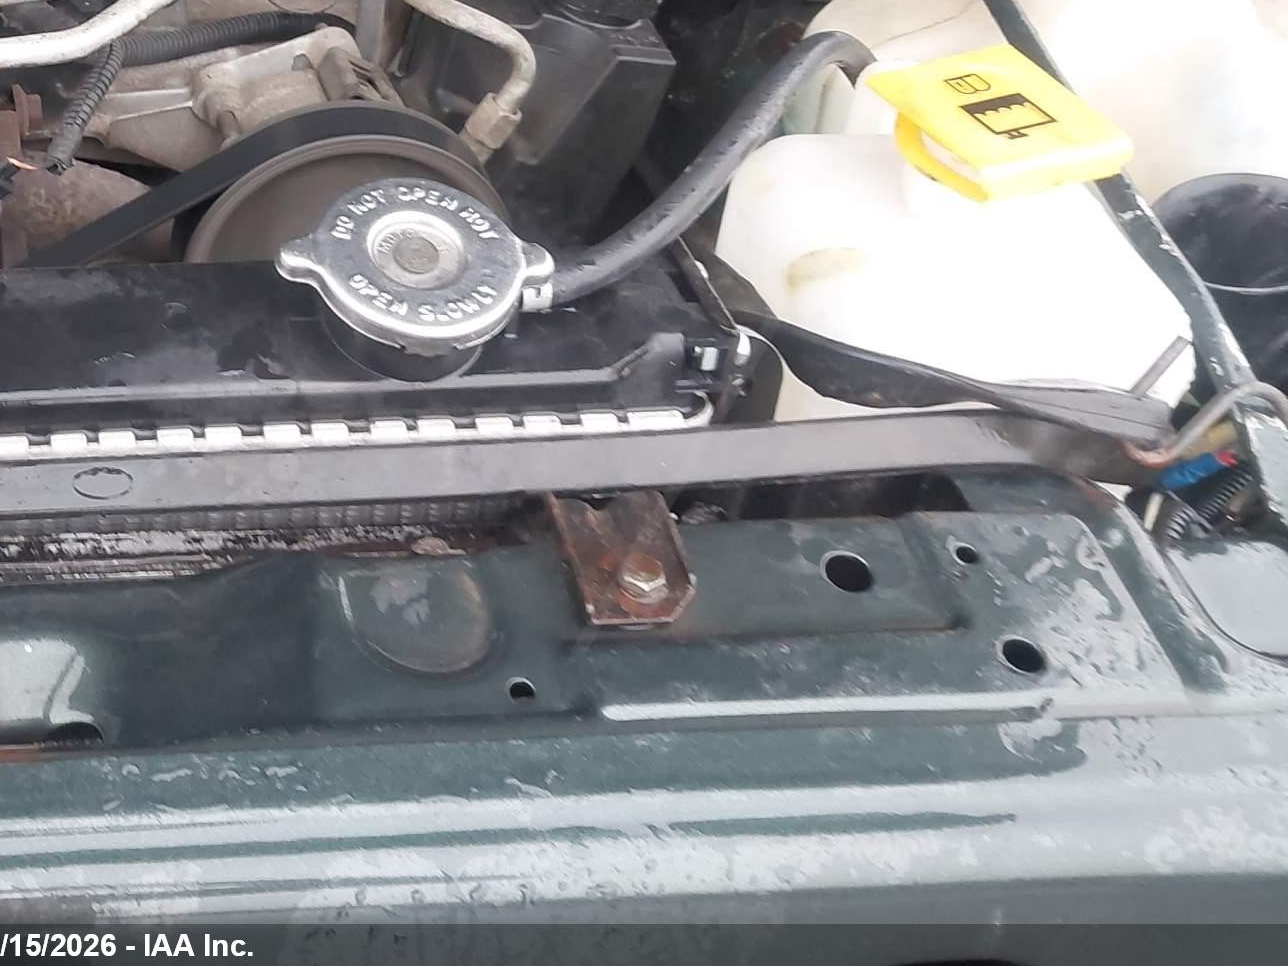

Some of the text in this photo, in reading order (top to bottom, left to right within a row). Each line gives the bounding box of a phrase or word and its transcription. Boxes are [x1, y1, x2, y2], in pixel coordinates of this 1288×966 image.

[331, 216, 355, 241] DO
[347, 188, 388, 216] NOT
[396, 186, 458, 211] OPEN
[459, 207, 501, 241] HOT
[350, 275, 498, 322] OPEN SLOWLY
